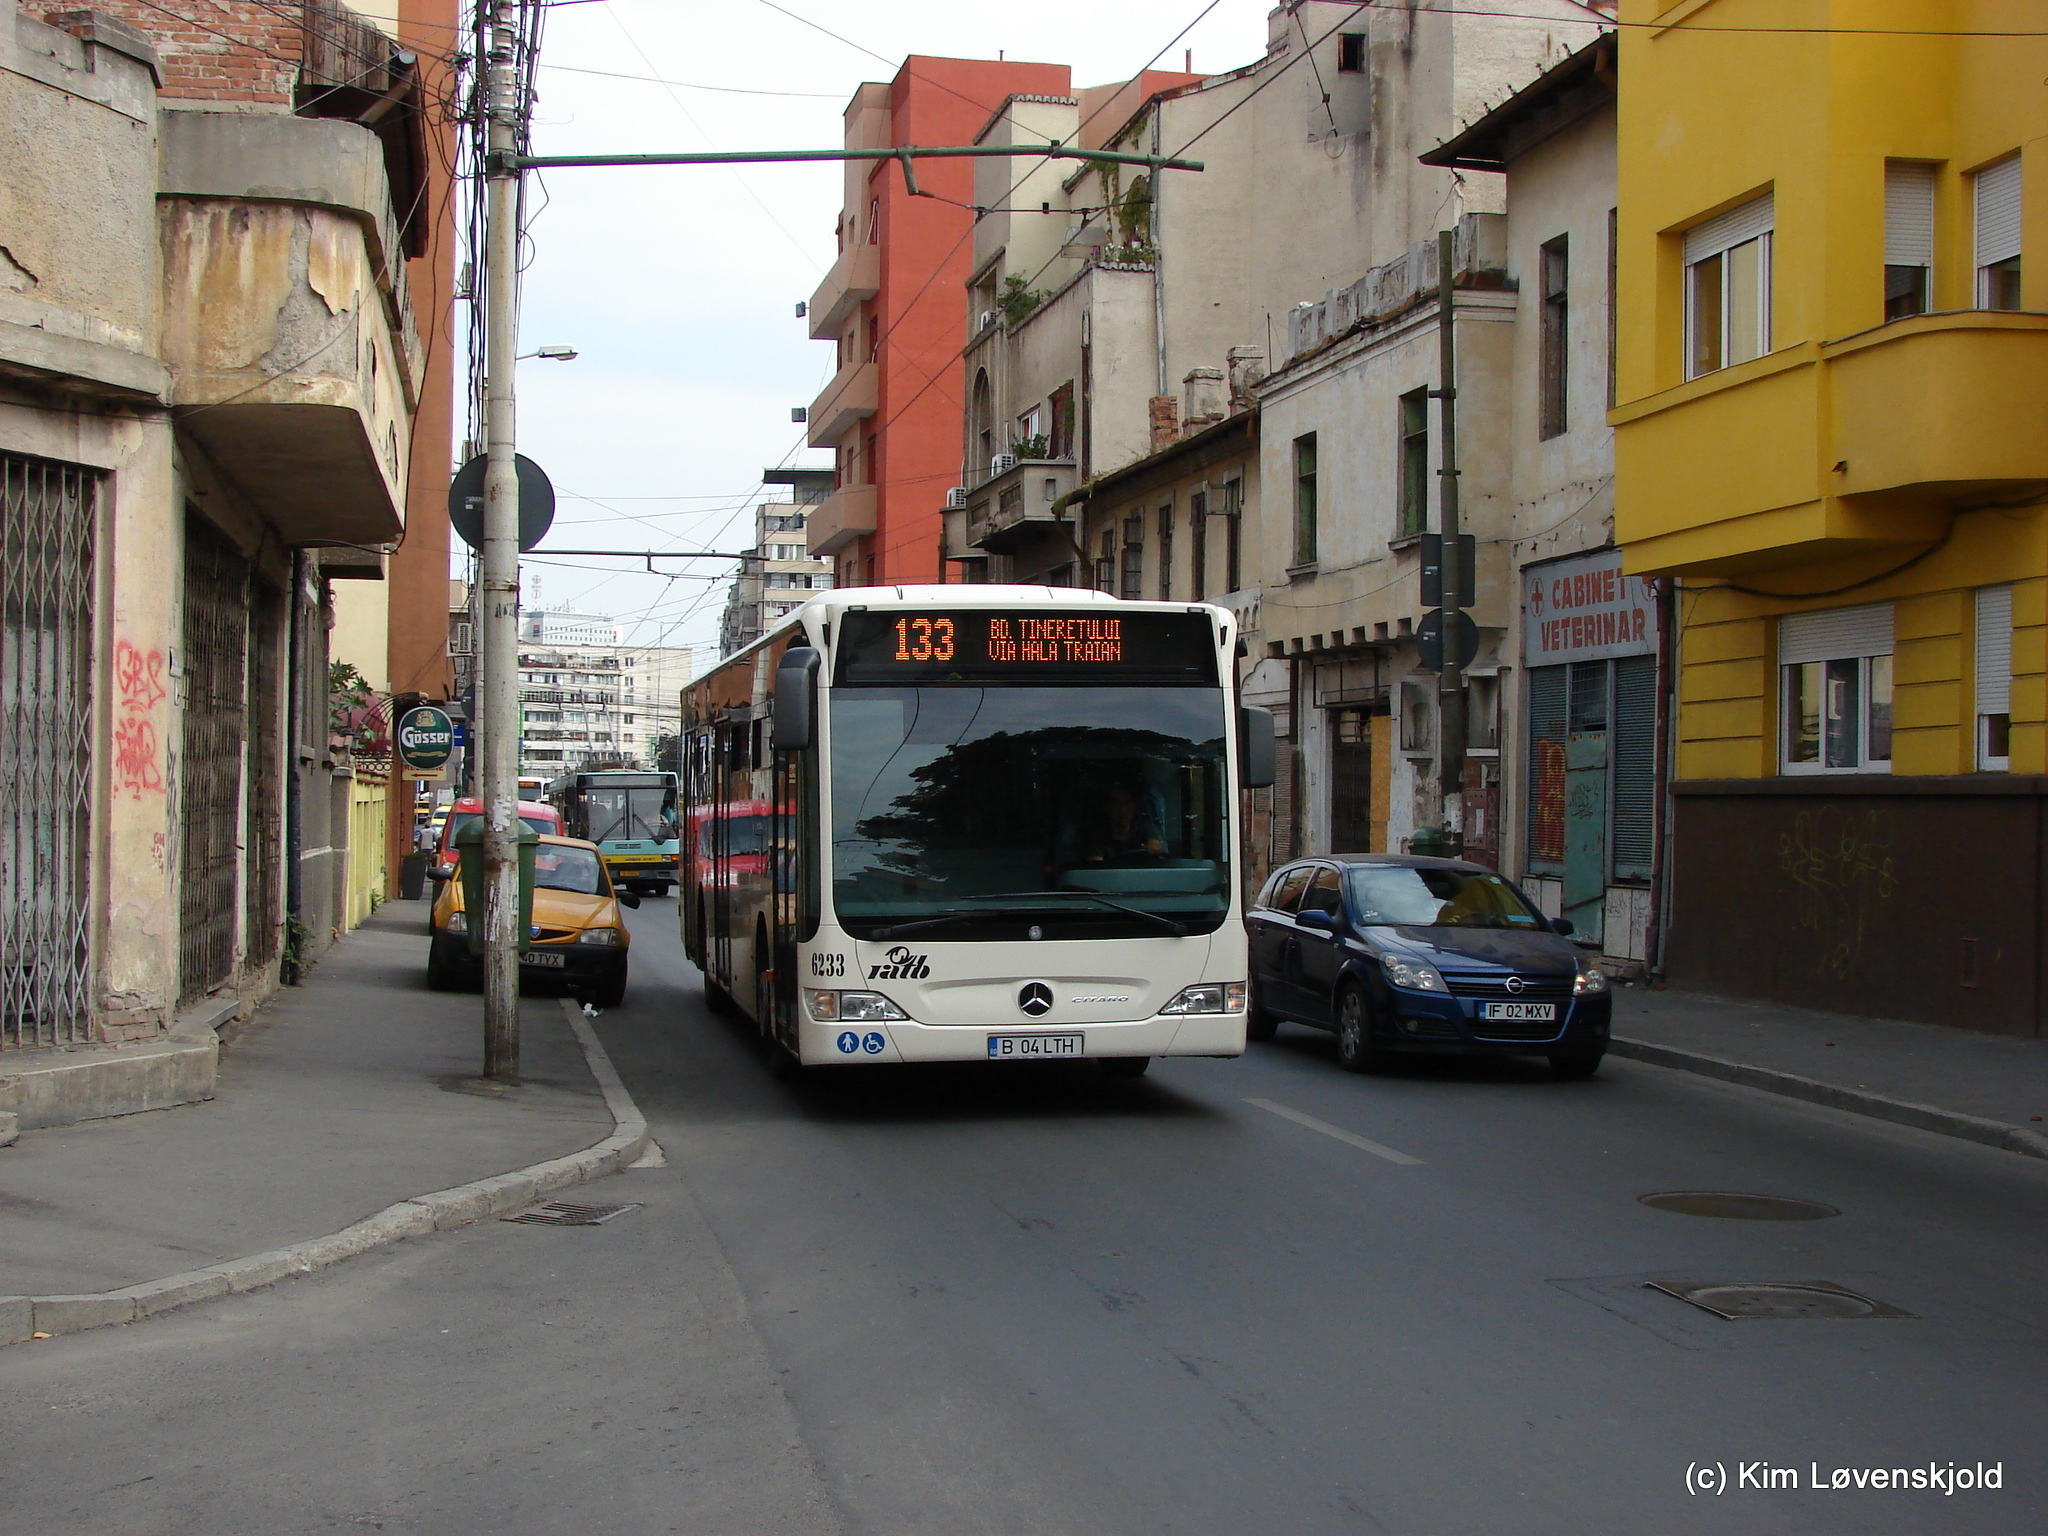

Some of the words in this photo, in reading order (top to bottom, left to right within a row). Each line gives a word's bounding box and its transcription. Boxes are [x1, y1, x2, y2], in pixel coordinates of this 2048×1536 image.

[1552, 567, 1625, 610] CABINET
[895, 618, 953, 661] 133
[990, 618, 1012, 640] BD.
[1018, 618, 1121, 640] TINERETULUI
[1541, 607, 1646, 652] VETERINAR
[989, 640, 1016, 661] VIA
[1021, 640, 1058, 661] HALA
[1063, 640, 1121, 661] TRAIAN
[401, 726, 451, 749] Gösser
[538, 954, 559, 966] TYX
[811, 953, 845, 977] 6233
[1071, 995, 1129, 1004] CITARO
[1489, 1004, 1502, 1018] IF
[1506, 1004, 1522, 1018] 02
[1525, 1005, 1552, 1019] MXV
[1002, 1039, 1013, 1055] B
[1021, 1039, 1039, 1054] 04
[1043, 1038, 1074, 1054] LTH
